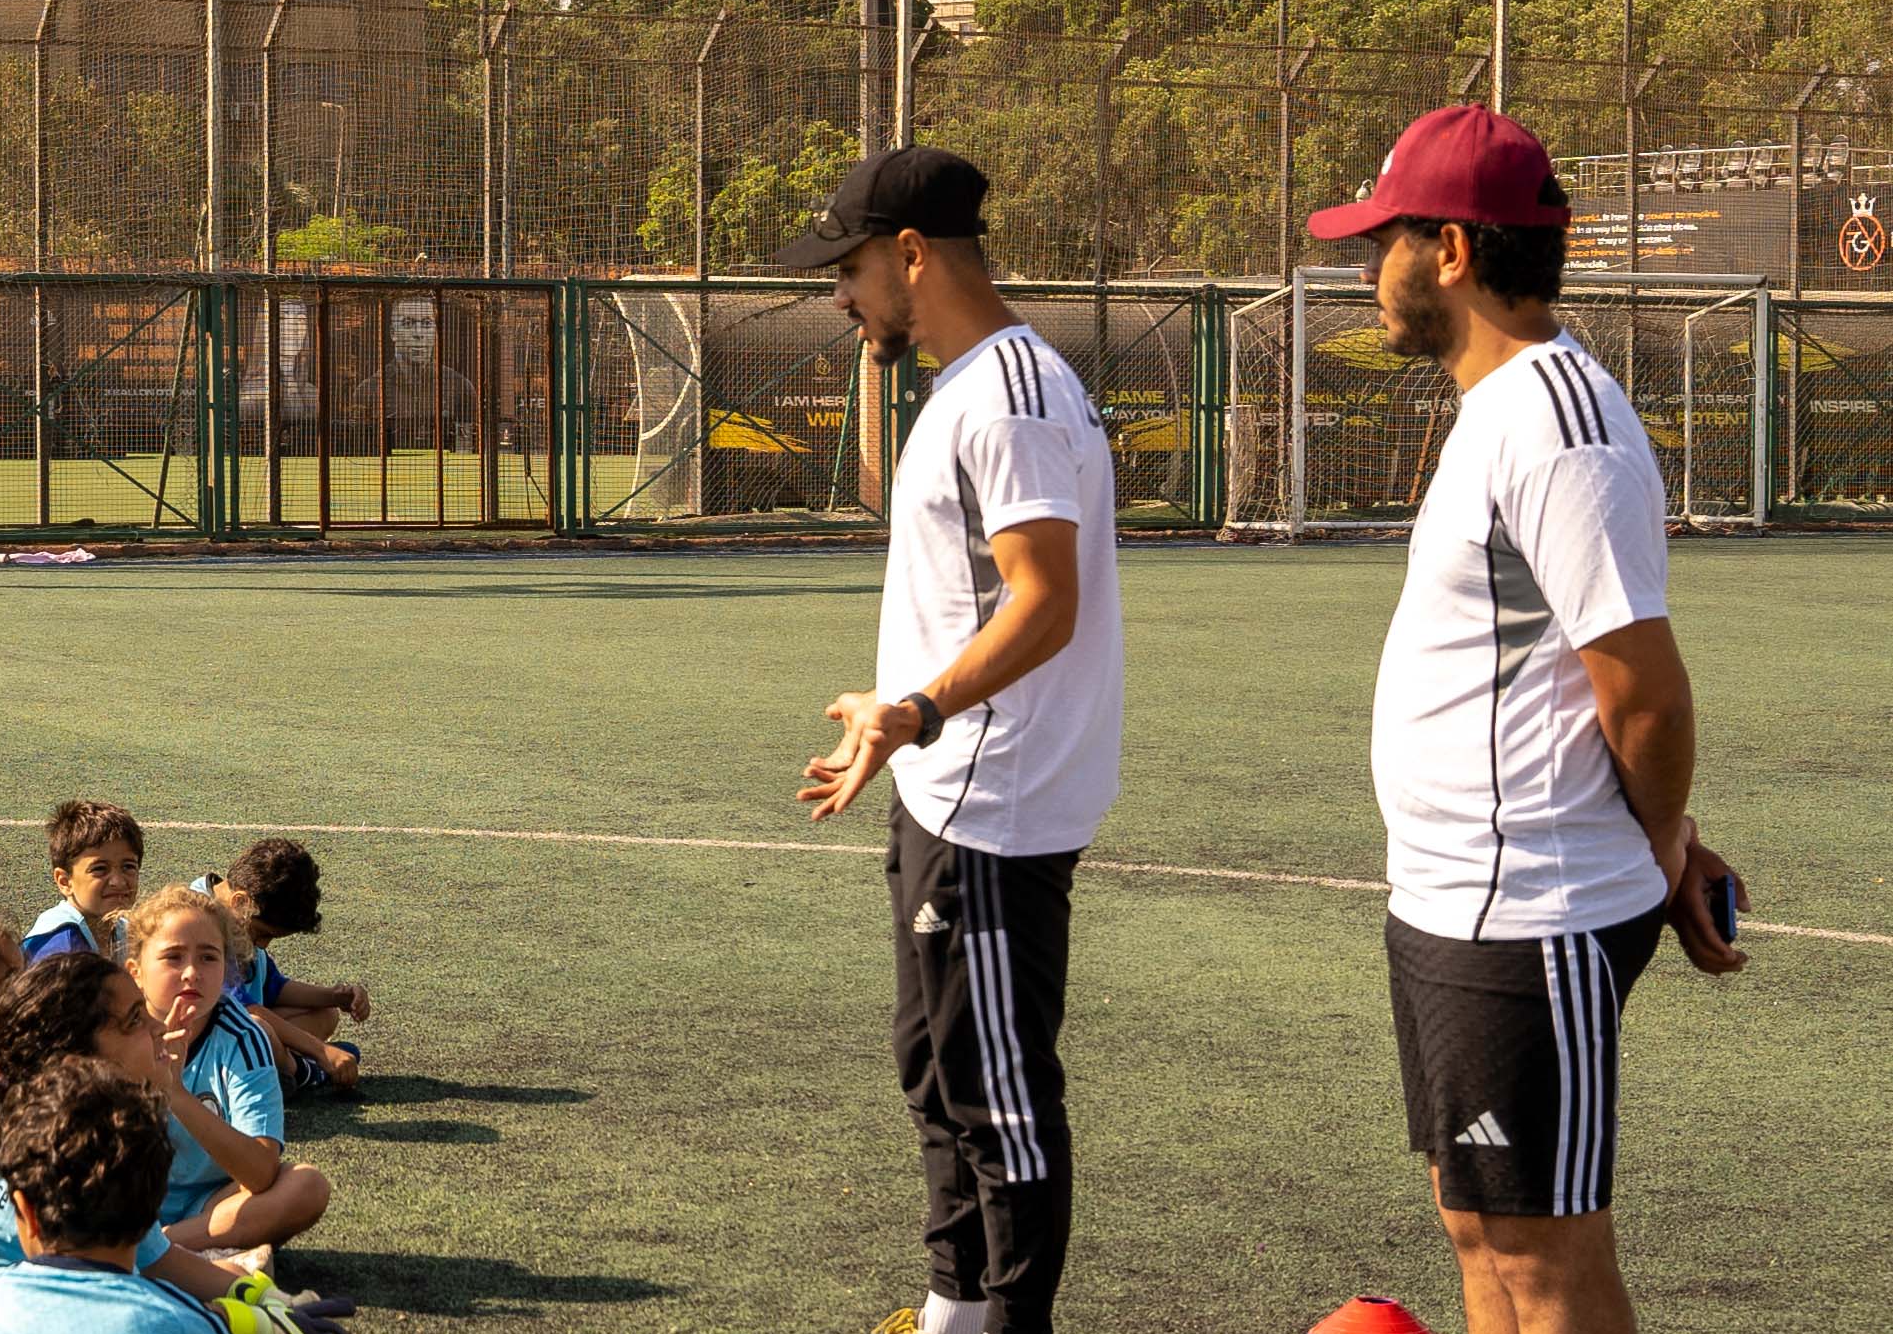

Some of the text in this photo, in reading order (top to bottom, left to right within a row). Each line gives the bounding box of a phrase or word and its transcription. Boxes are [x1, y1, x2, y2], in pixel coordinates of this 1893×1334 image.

[782, 396, 809, 407] AM
[812, 396, 849, 407] HER
[1810, 400, 1877, 413] INSPIRE
